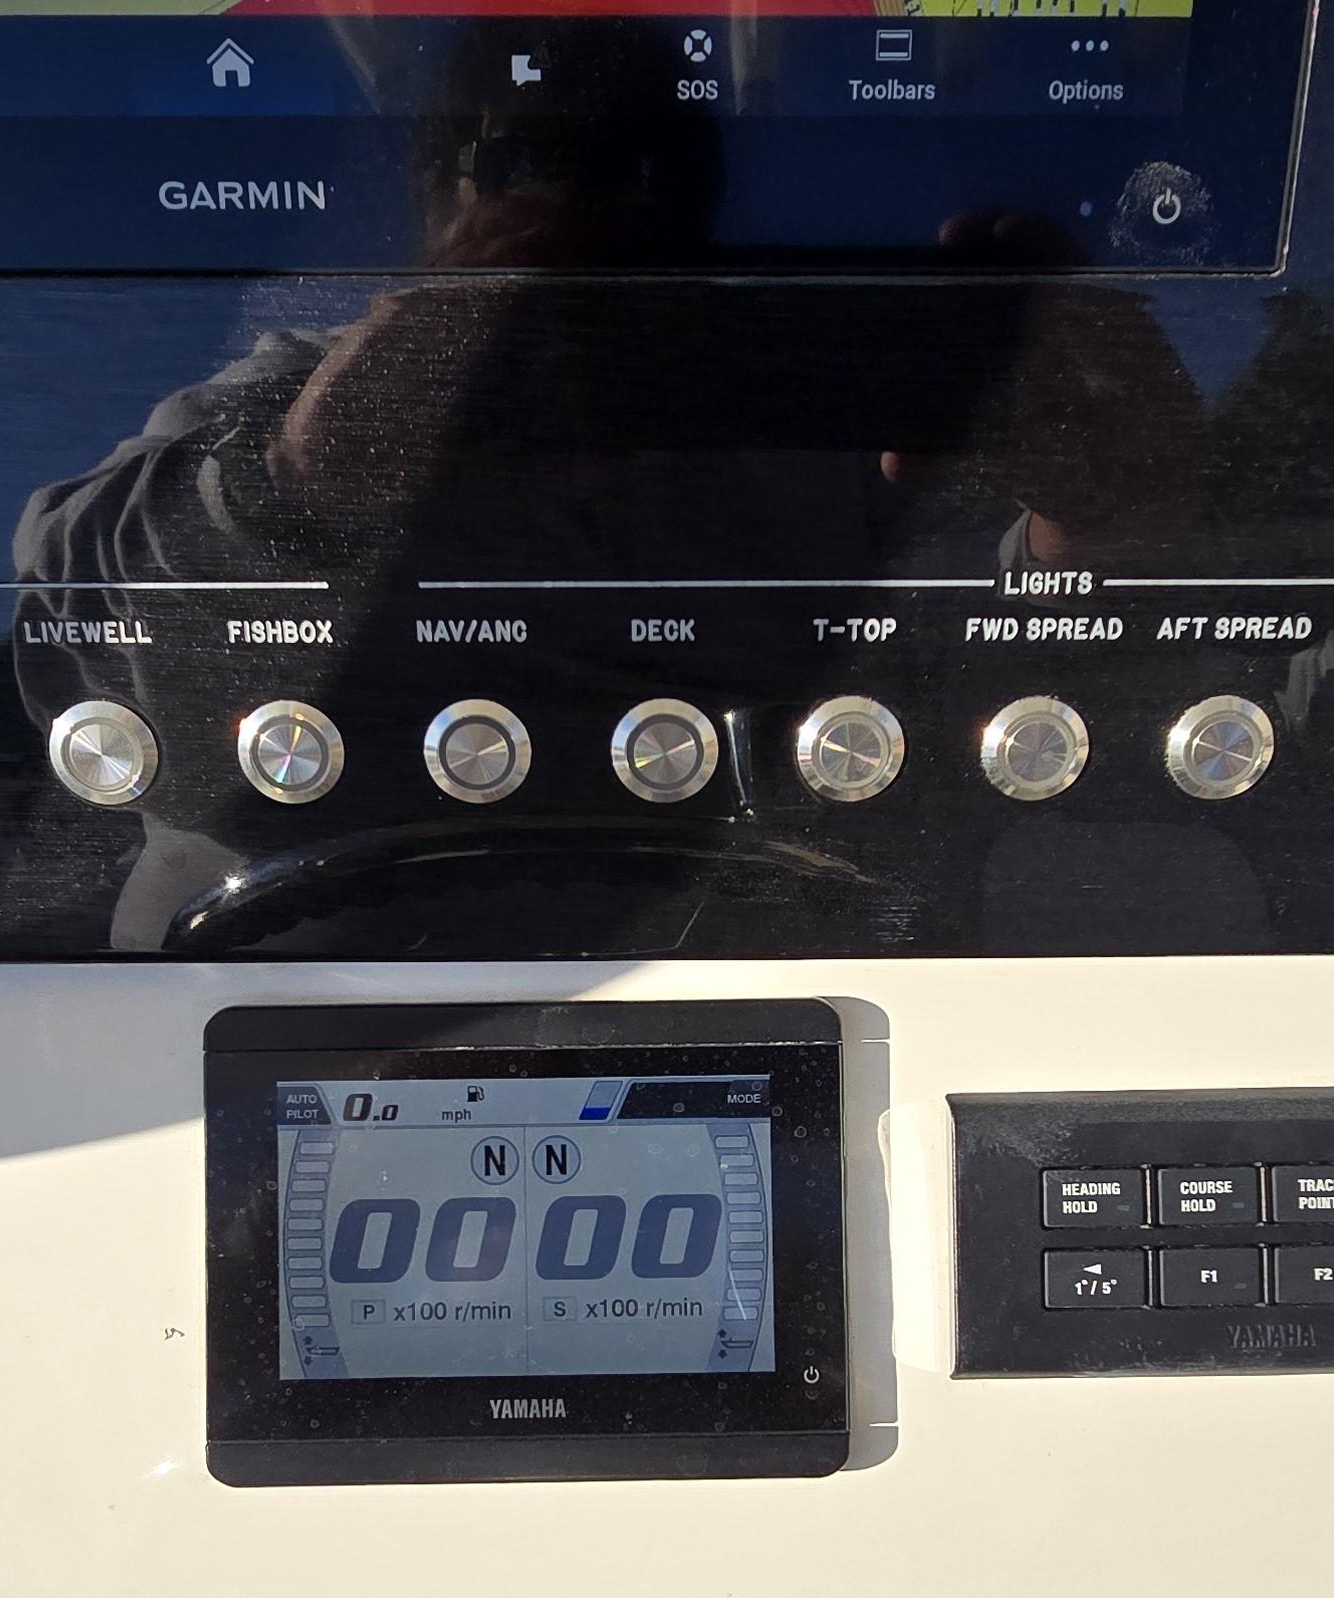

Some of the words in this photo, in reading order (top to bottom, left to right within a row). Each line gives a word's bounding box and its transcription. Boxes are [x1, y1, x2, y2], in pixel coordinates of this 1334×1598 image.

[676, 79, 719, 100] SOS
[849, 79, 936, 101] Toolbars
[1048, 80, 1124, 104] Options
[158, 180, 326, 210] GARMIN
[1004, 571, 1093, 596] LIGHTS
[23, 620, 153, 645] LIVEWELL
[227, 619, 334, 644] FISHBOX
[415, 619, 528, 643] NAV/ANC
[630, 619, 696, 642] DECK
[813, 617, 897, 642] T-TOP
[965, 618, 1019, 642] FWD
[1025, 617, 1124, 641] SPREAD
[1156, 617, 1207, 640] AFT
[1213, 616, 1313, 640] SPREAD
[285, 1094, 317, 1105] AUTO
[342, 1093, 399, 1122] 0.0
[726, 1093, 762, 1105] MODE
[285, 1108, 319, 1119] PILOT
[441, 1109, 472, 1124] mph
[483, 1144, 508, 1177] N
[545, 1143, 570, 1176] N
[1062, 1183, 1121, 1196] HEADING
[1180, 1181, 1233, 1194] COURSE
[1062, 1201, 1098, 1214] HOLD
[1181, 1199, 1216, 1212] HOLD
[329, 1197, 517, 1284] 00
[535, 1193, 723, 1280] 00
[1201, 1270, 1218, 1283] F1
[1314, 1268, 1334, 1281] F2
[362, 1304, 376, 1320] P
[394, 1302, 448, 1321] x100
[454, 1301, 512, 1321] r/min
[553, 1302, 567, 1317] S
[586, 1299, 639, 1318] x100
[645, 1298, 704, 1318] r/min
[1227, 1323, 1317, 1348] YAMAHA
[489, 1398, 567, 1419] YAMAHA
